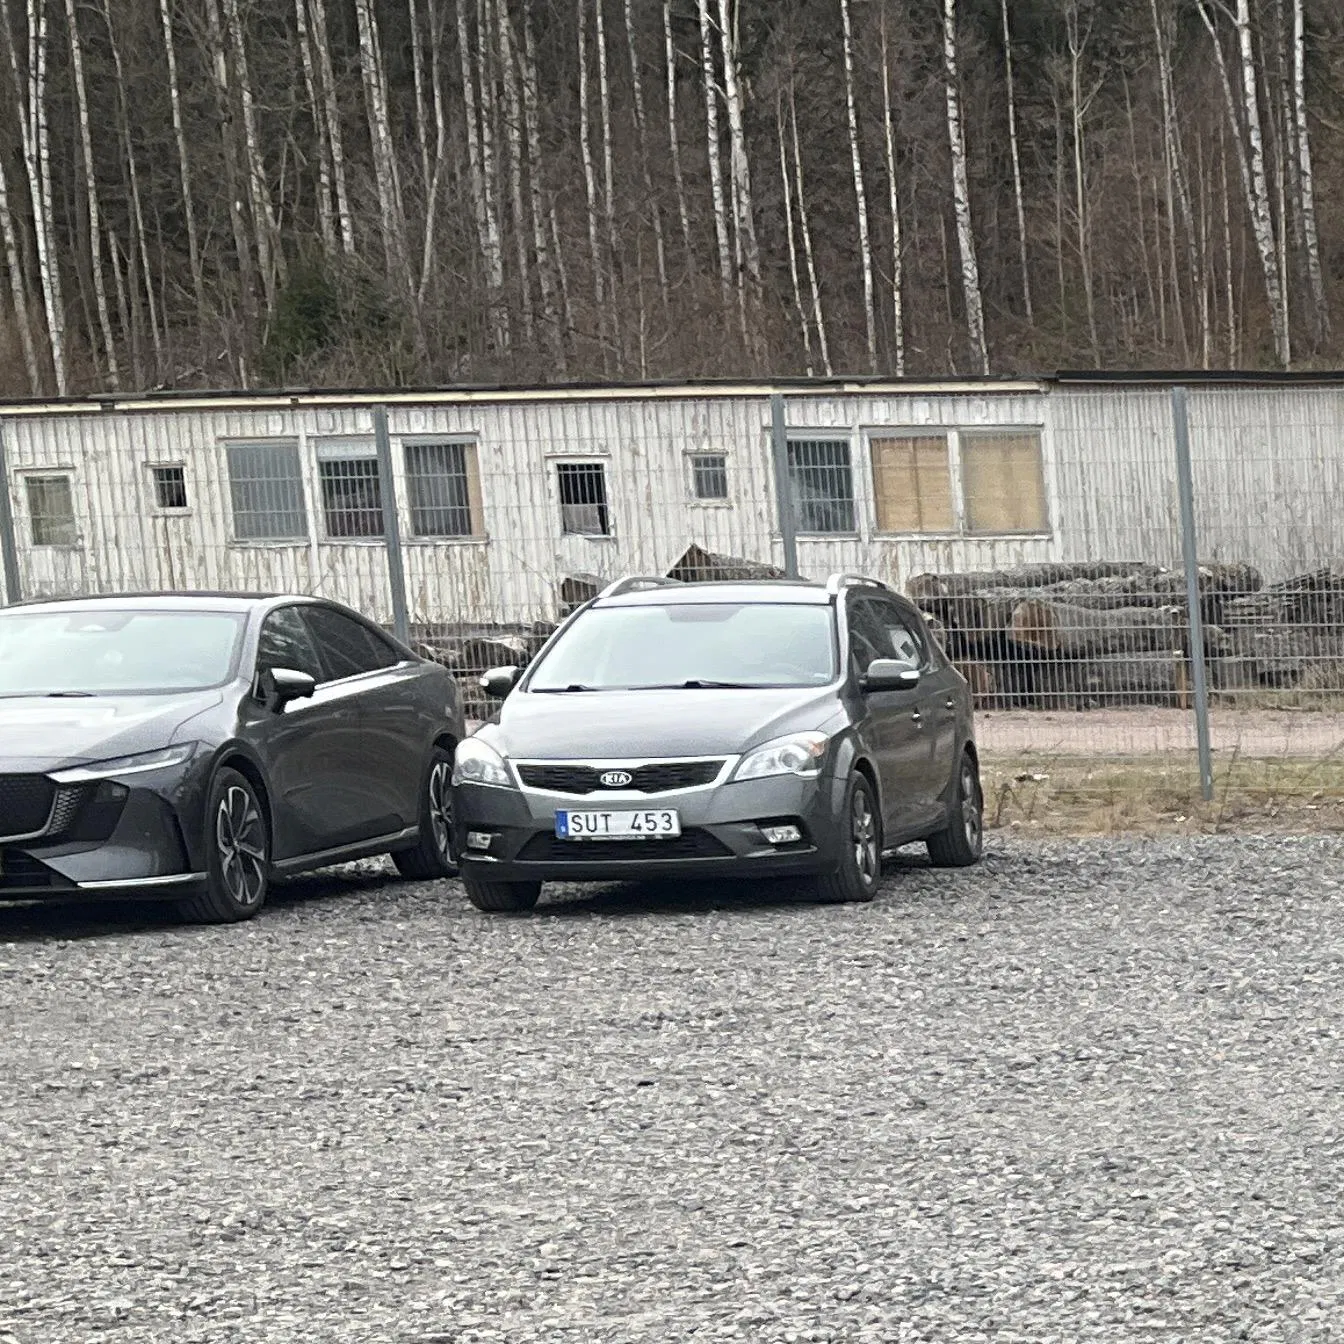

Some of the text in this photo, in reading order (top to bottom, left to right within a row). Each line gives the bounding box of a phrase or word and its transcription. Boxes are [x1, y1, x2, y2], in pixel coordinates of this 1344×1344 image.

[605, 773, 628, 784] KIA
[571, 812, 673, 833] SUT 453
